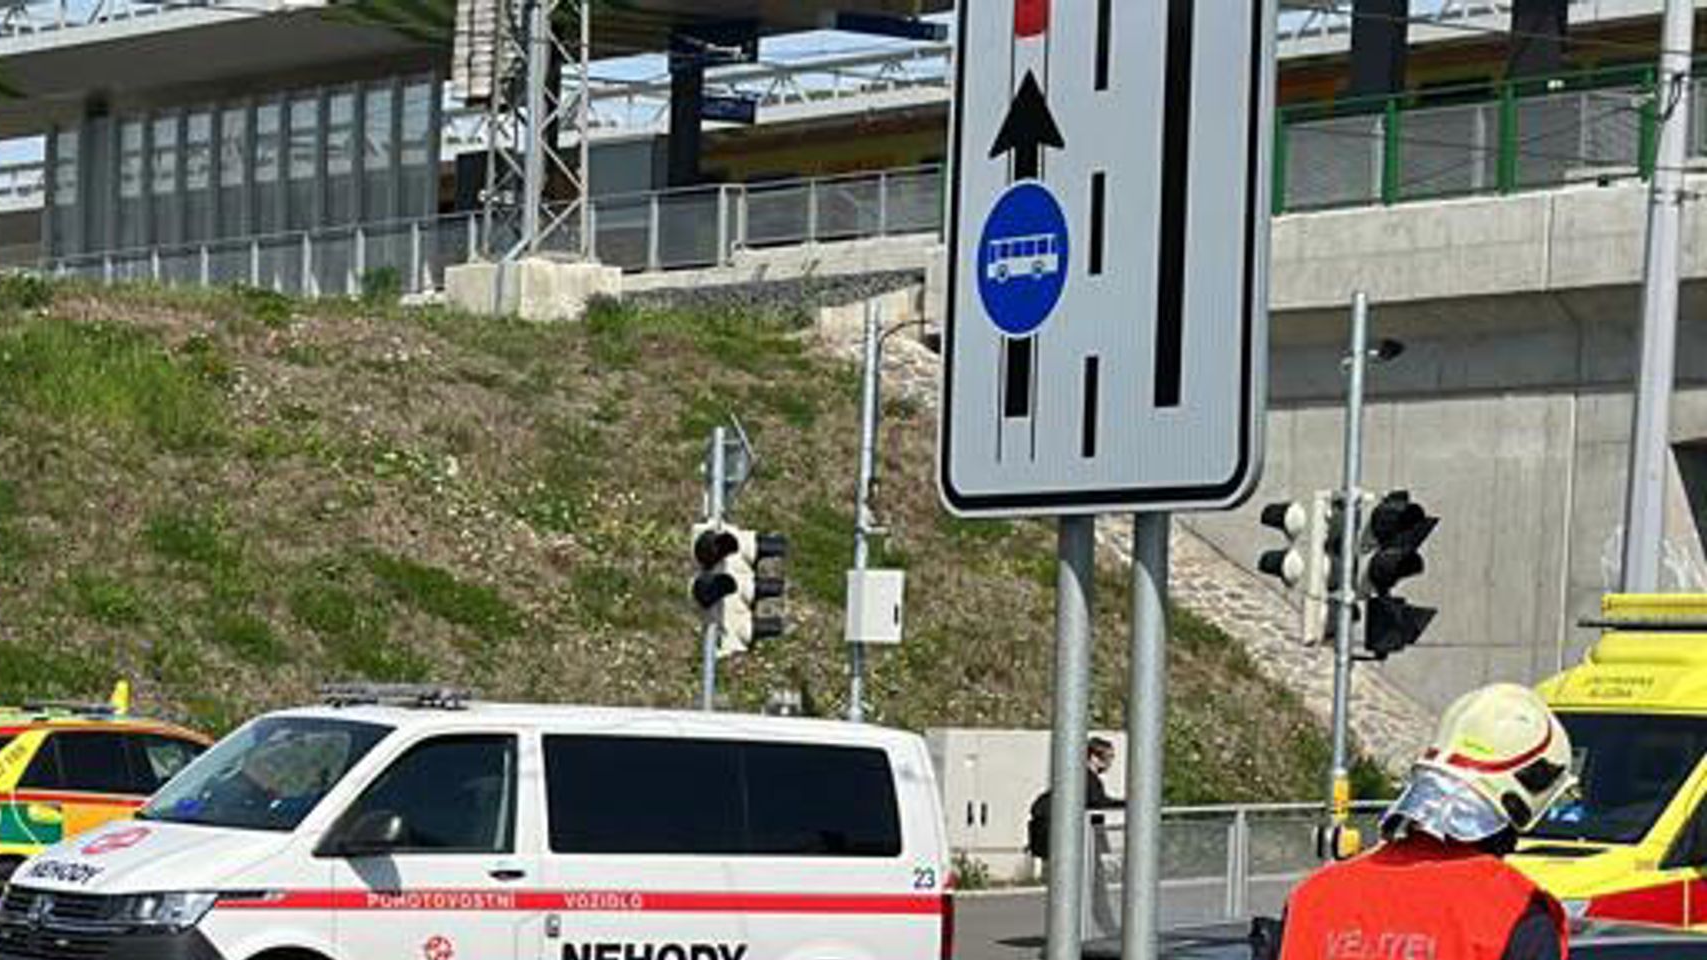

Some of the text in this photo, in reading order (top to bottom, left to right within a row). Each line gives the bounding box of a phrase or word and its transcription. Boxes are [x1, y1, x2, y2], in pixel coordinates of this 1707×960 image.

[913, 867, 936, 889] 23
[367, 891, 643, 910] POHOTOVOSTNÍ VOZIDLO
